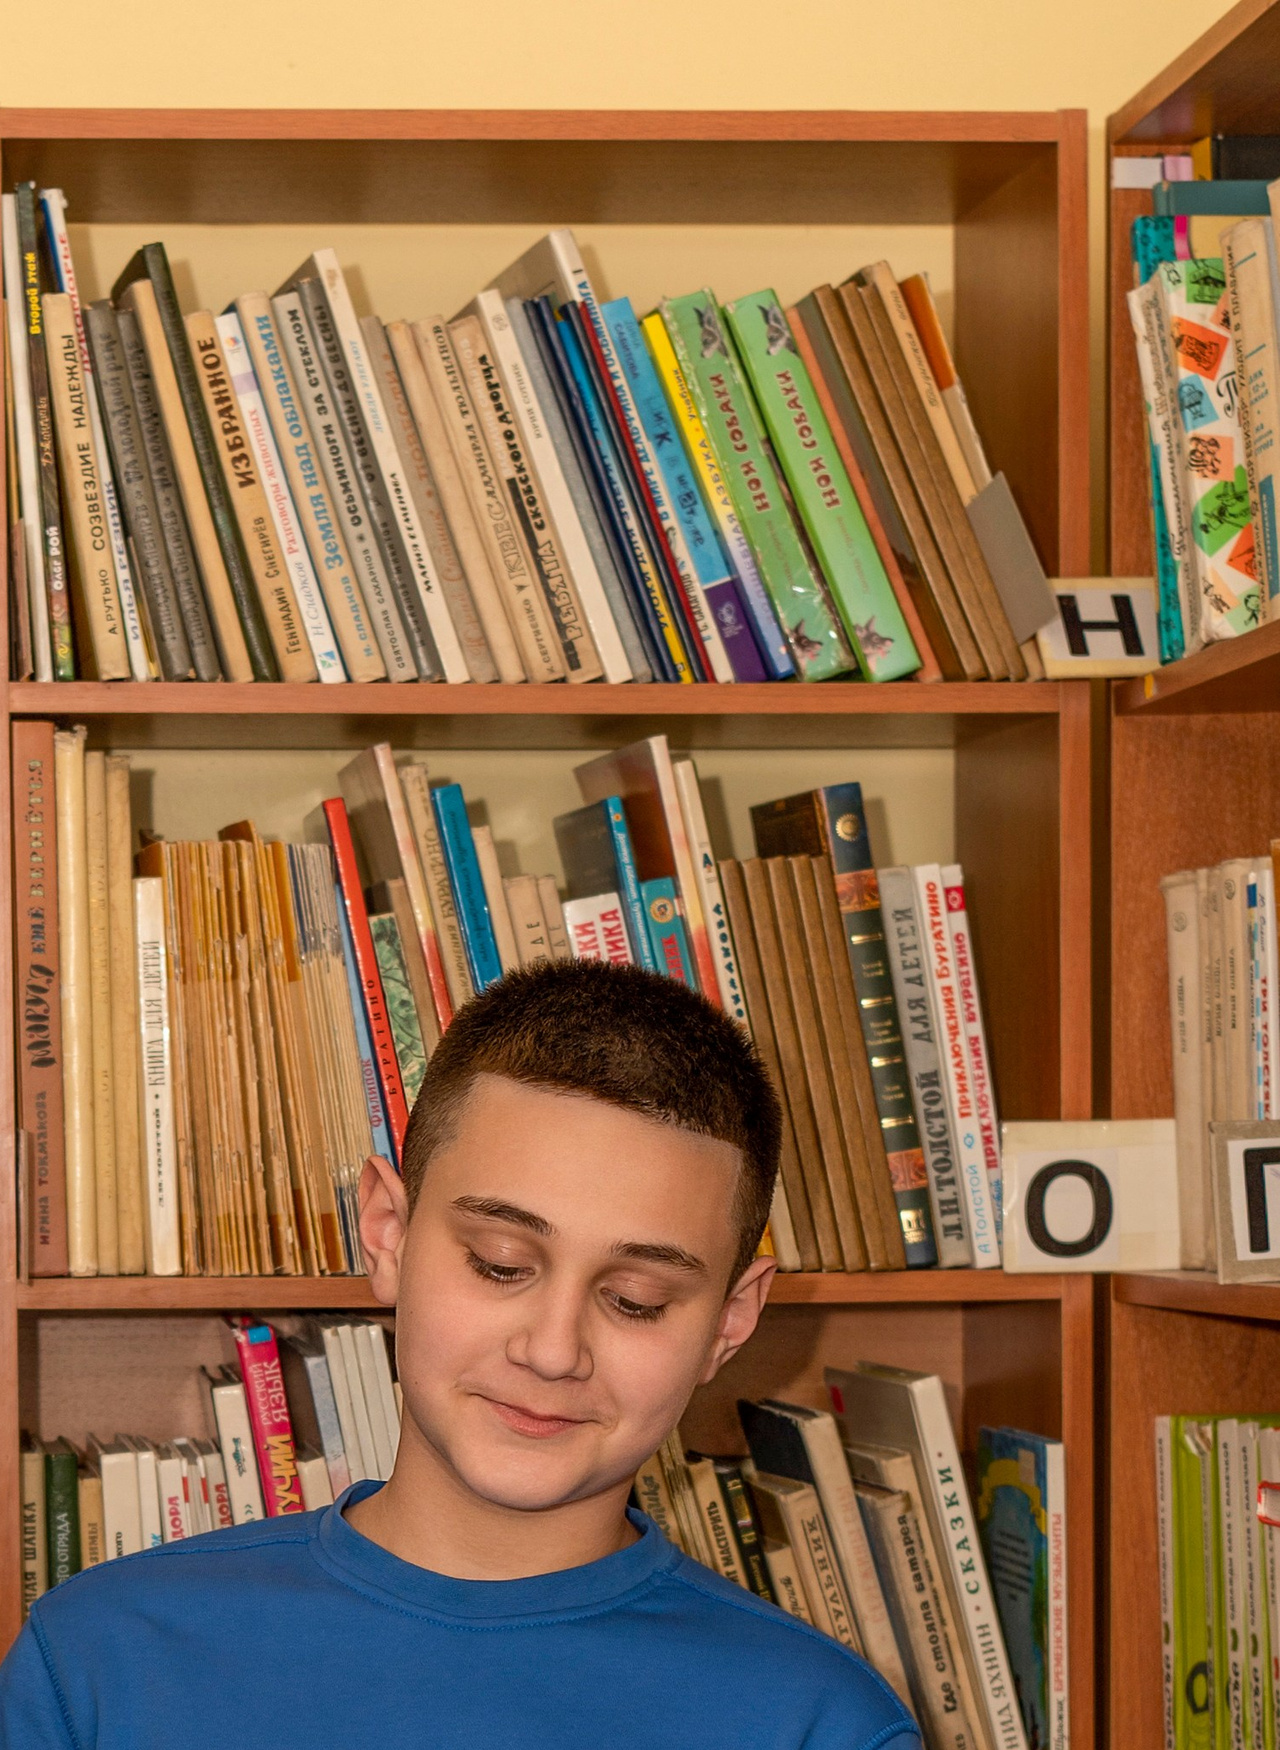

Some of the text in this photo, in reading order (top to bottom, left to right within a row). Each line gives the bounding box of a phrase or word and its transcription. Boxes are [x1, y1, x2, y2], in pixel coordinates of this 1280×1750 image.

[24, 251, 41, 335] Второй этаж
[287, 308, 320, 388] СТЕКЛОМ
[196, 336, 256, 489] ИЗБРАННОЕ
[314, 392, 329, 417] ЗА
[477, 353, 514, 426] ДВОРЦА
[708, 372, 749, 454] СОБАКИ
[774, 368, 818, 450] СОБАКИ
[61, 334, 105, 551] СОЗВЕЗДИЕ НАДЕЖДЫ
[248, 408, 277, 478] животных
[254, 314, 345, 571] Земля над облаками
[321, 423, 363, 527] ОСЬМИНОГИ
[252, 516, 280, 579] СНЕГИРЁВ
[270, 480, 300, 555] Разговоры
[361, 548, 386, 605] САХАРНОВ
[536, 539, 584, 641] РЕБЯТА
[1057, 594, 1148, 656] Н
[24, 759, 45, 898] ВЕРНЁТСЯ
[423, 827, 455, 918] БУРАТИНО
[141, 939, 165, 1087] КНИГА ДЛЯ ДЕТЕЙ
[891, 906, 935, 1044] ДЛЯ ДЕТЕЙ
[924, 880, 973, 1120] ПРИКЛЮЧЕНИЯ БУРАТИНО
[953, 932, 977, 1023] БУРАТИНО
[1260, 975, 1269, 1013] ТРИ
[366, 978, 398, 1097] БУРАТИНО
[359, 1057, 383, 1129] ФИЛИПОК
[967, 1034, 999, 1170] ПРИКЛЮЧЕНИЯ
[34, 1090, 50, 1188] ТОКМАКОВА
[38, 1195, 51, 1246] ИРИНА
[1024, 1158, 1114, 1259] О
[248, 1362, 273, 1426] РУССКИЙ
[265, 1357, 290, 1424] ЯЗЫК
[24, 1500, 37, 1562] ШАПКА
[88, 1522, 99, 1564] ЗИМЫ
[897, 1513, 926, 1594] батарея
[936, 1465, 981, 1595] СКАЗКИ
[1051, 1512, 1064, 1600] МУЗЫКАНТЫ
[920, 1599, 948, 1674] стояла
[975, 1621, 1007, 1699] ЯХНИН
[1052, 1604, 1068, 1693] БРЕМЕНСКИЕ
[941, 1680, 958, 1714] Где
